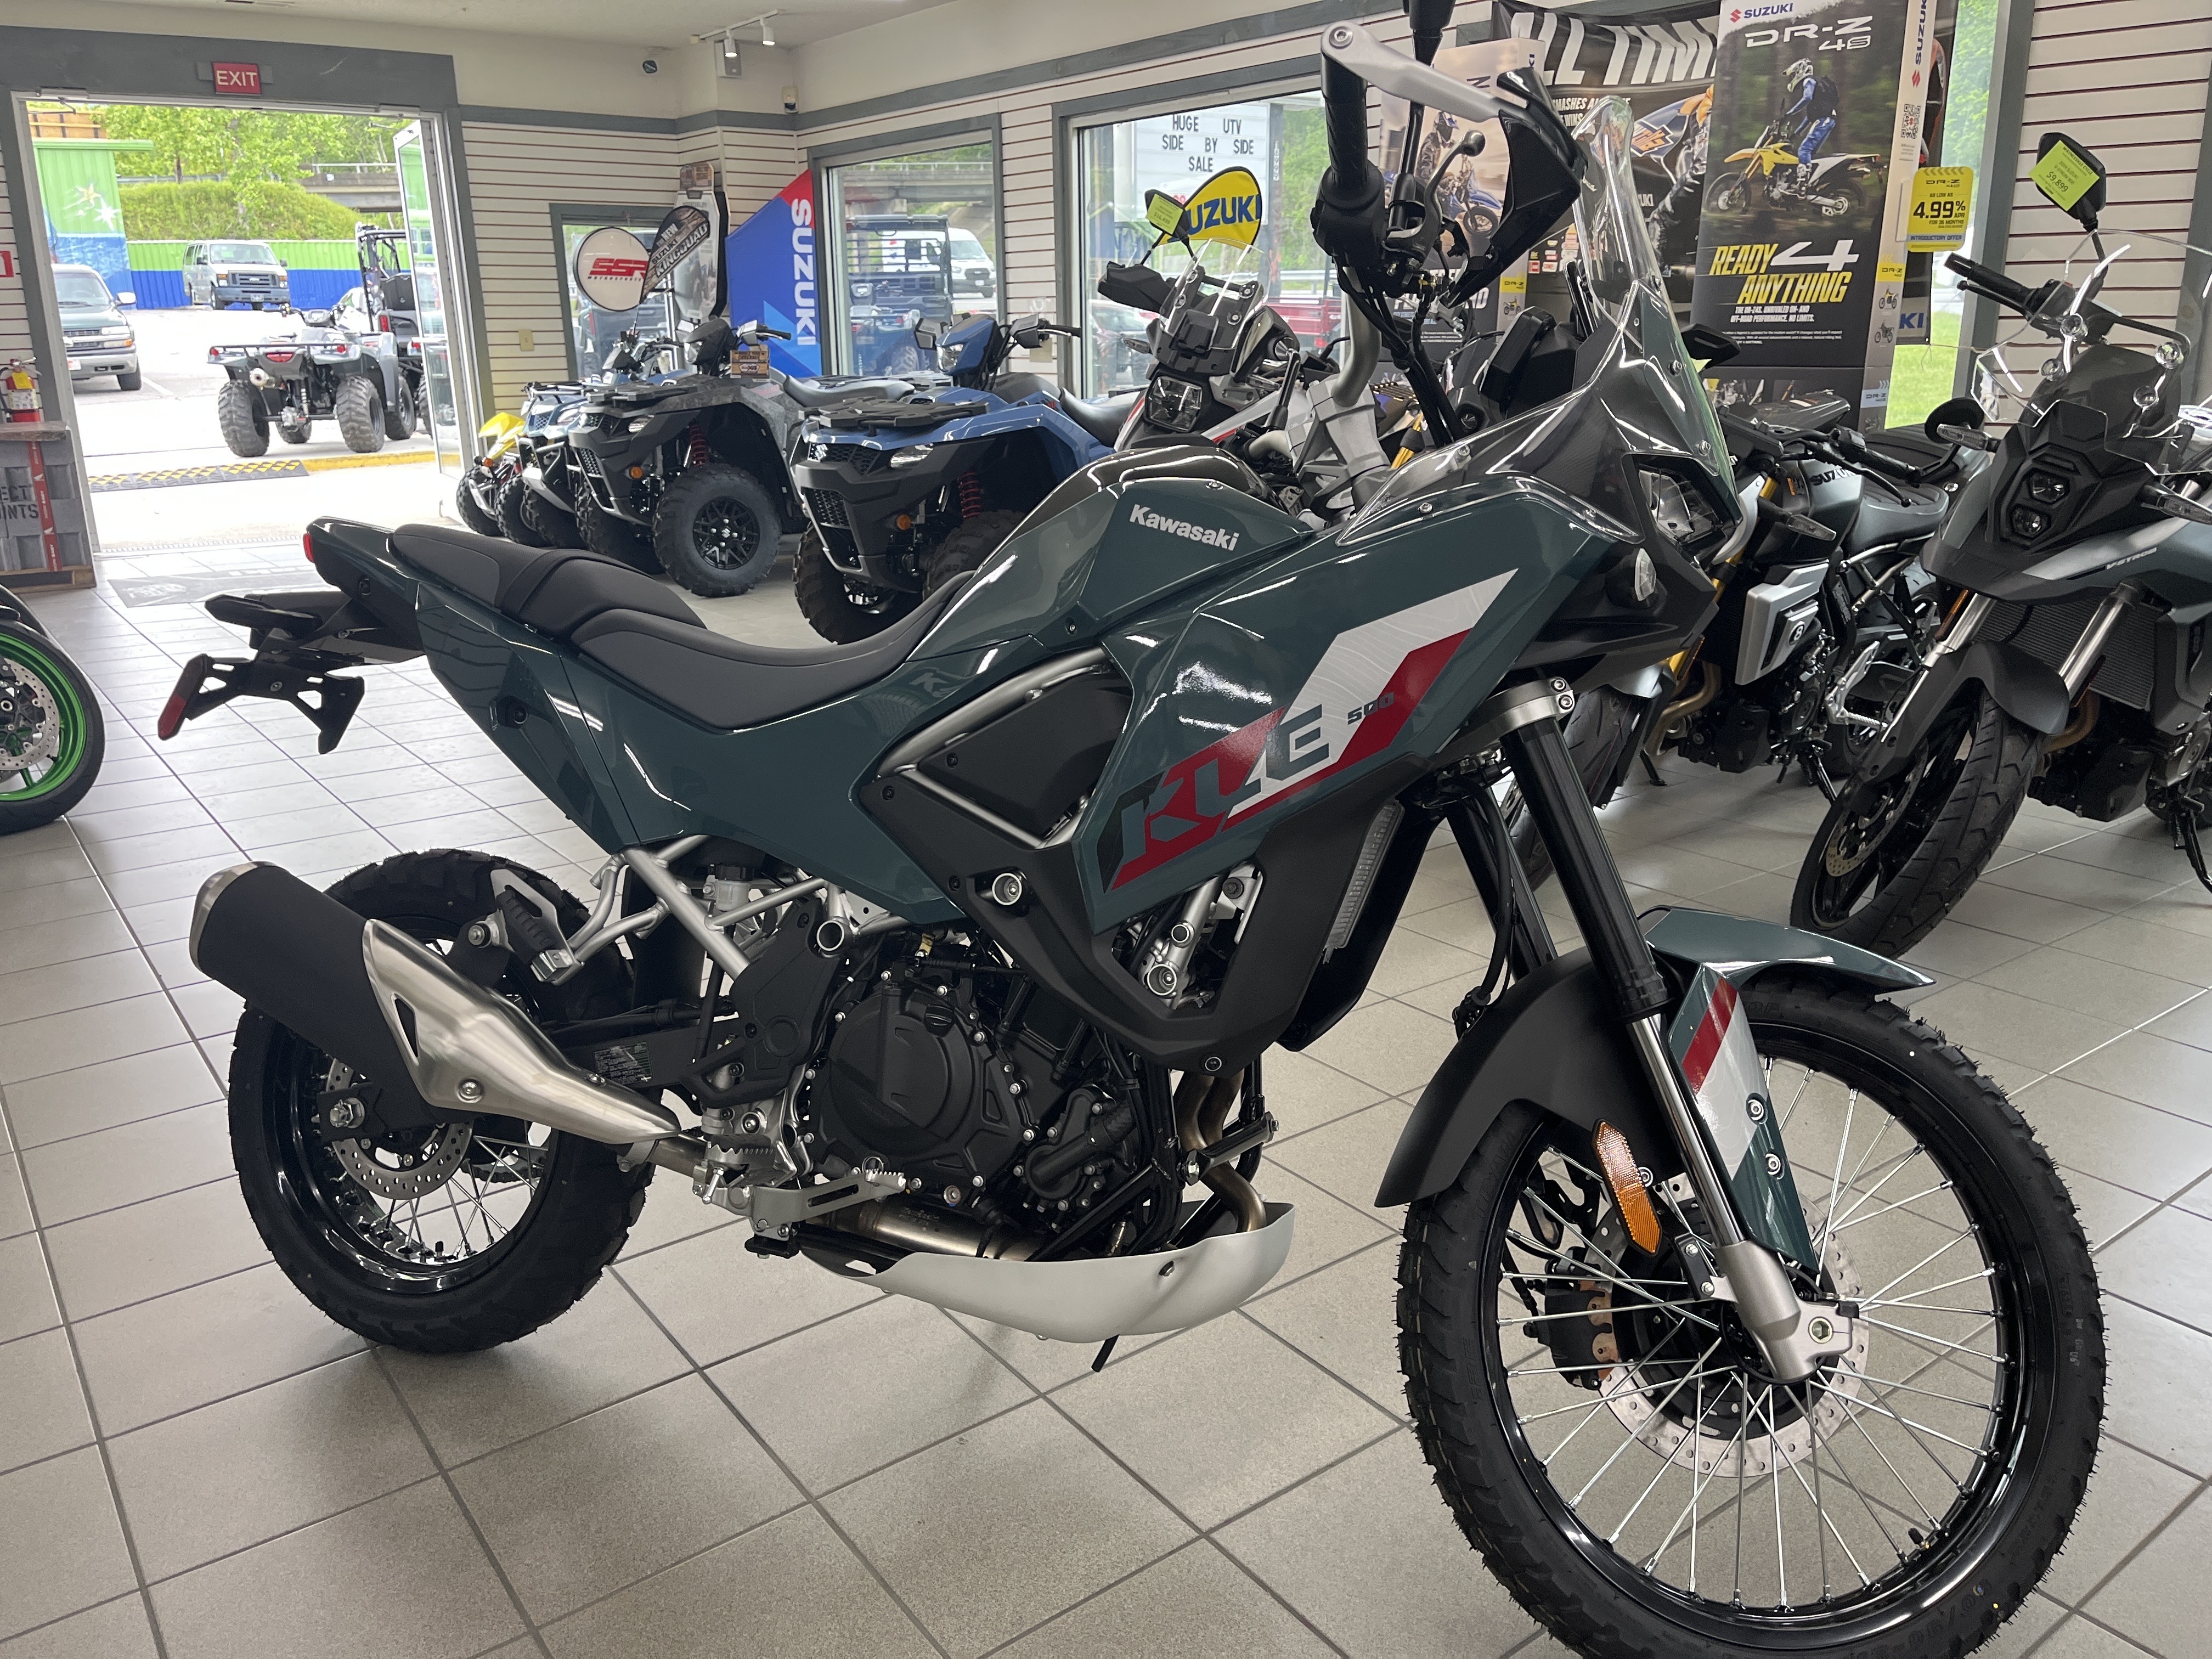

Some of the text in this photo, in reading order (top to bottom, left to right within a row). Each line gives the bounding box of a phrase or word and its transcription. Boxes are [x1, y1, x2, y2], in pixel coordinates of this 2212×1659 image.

[1743, 3, 1793, 19] SUZUKI
[1745, 15, 1873, 48] DR-Z
[1594, 15, 1722, 83] TIM
[216, 70, 258, 87] EXIT
[1172, 114, 1242, 134] HUGE UTV
[1162, 134, 1254, 155] SIDE BY SIDE
[1188, 156, 1214, 172] SALE
[2046, 171, 2068, 192] $9,899
[1185, 194, 1261, 236] UZUKI
[661, 223, 679, 241] NEW
[651, 239, 679, 264] SUZUKI
[655, 224, 709, 277] KINGQUAD
[1708, 239, 1859, 275] READY 4
[589, 257, 648, 279] SSR
[791, 198, 816, 345] SUZUKI
[1736, 272, 1853, 304] ANYTHING
[1129, 504, 1240, 551] Kawasaki
[1347, 691, 1395, 725] 500
[1122, 704, 1330, 864] KLE
